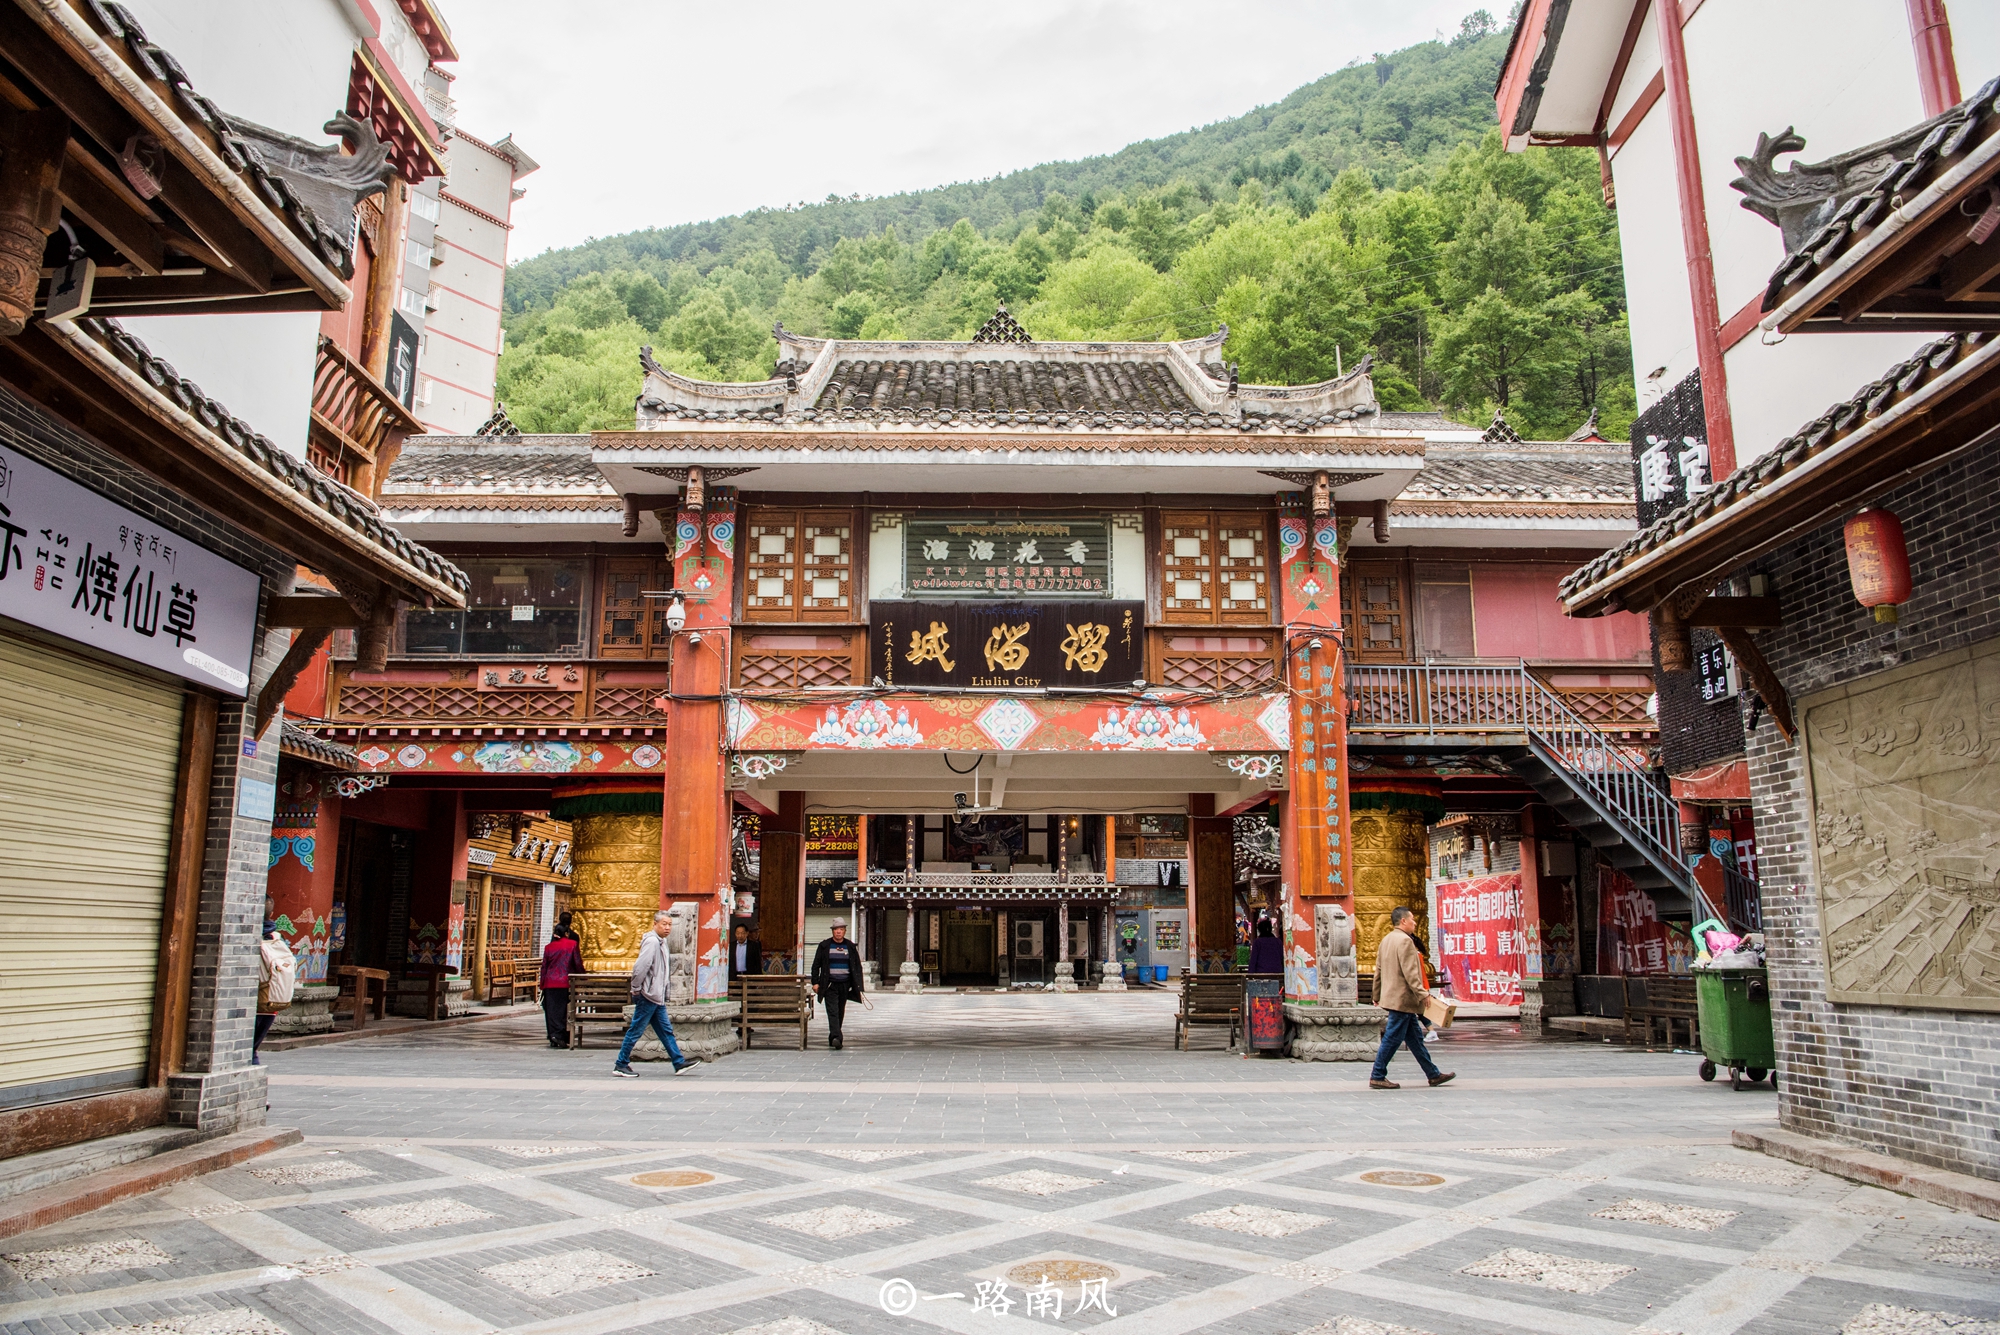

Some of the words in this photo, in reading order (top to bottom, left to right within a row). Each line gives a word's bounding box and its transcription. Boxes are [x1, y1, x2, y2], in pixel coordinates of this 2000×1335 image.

[1641, 435, 1712, 501] 康定
[922, 538, 1090, 565] 溜溜花香
[1851, 521, 1882, 594] 康定老街
[71, 542, 199, 648] 燒仙草
[971, 676, 1010, 686] Liuliu
[1014, 676, 1041, 688] City
[1442, 889, 1524, 924] 立成电脑即将
[1443, 931, 1487, 955] 施工重地
[1468, 968, 1522, 997] 注意安全
